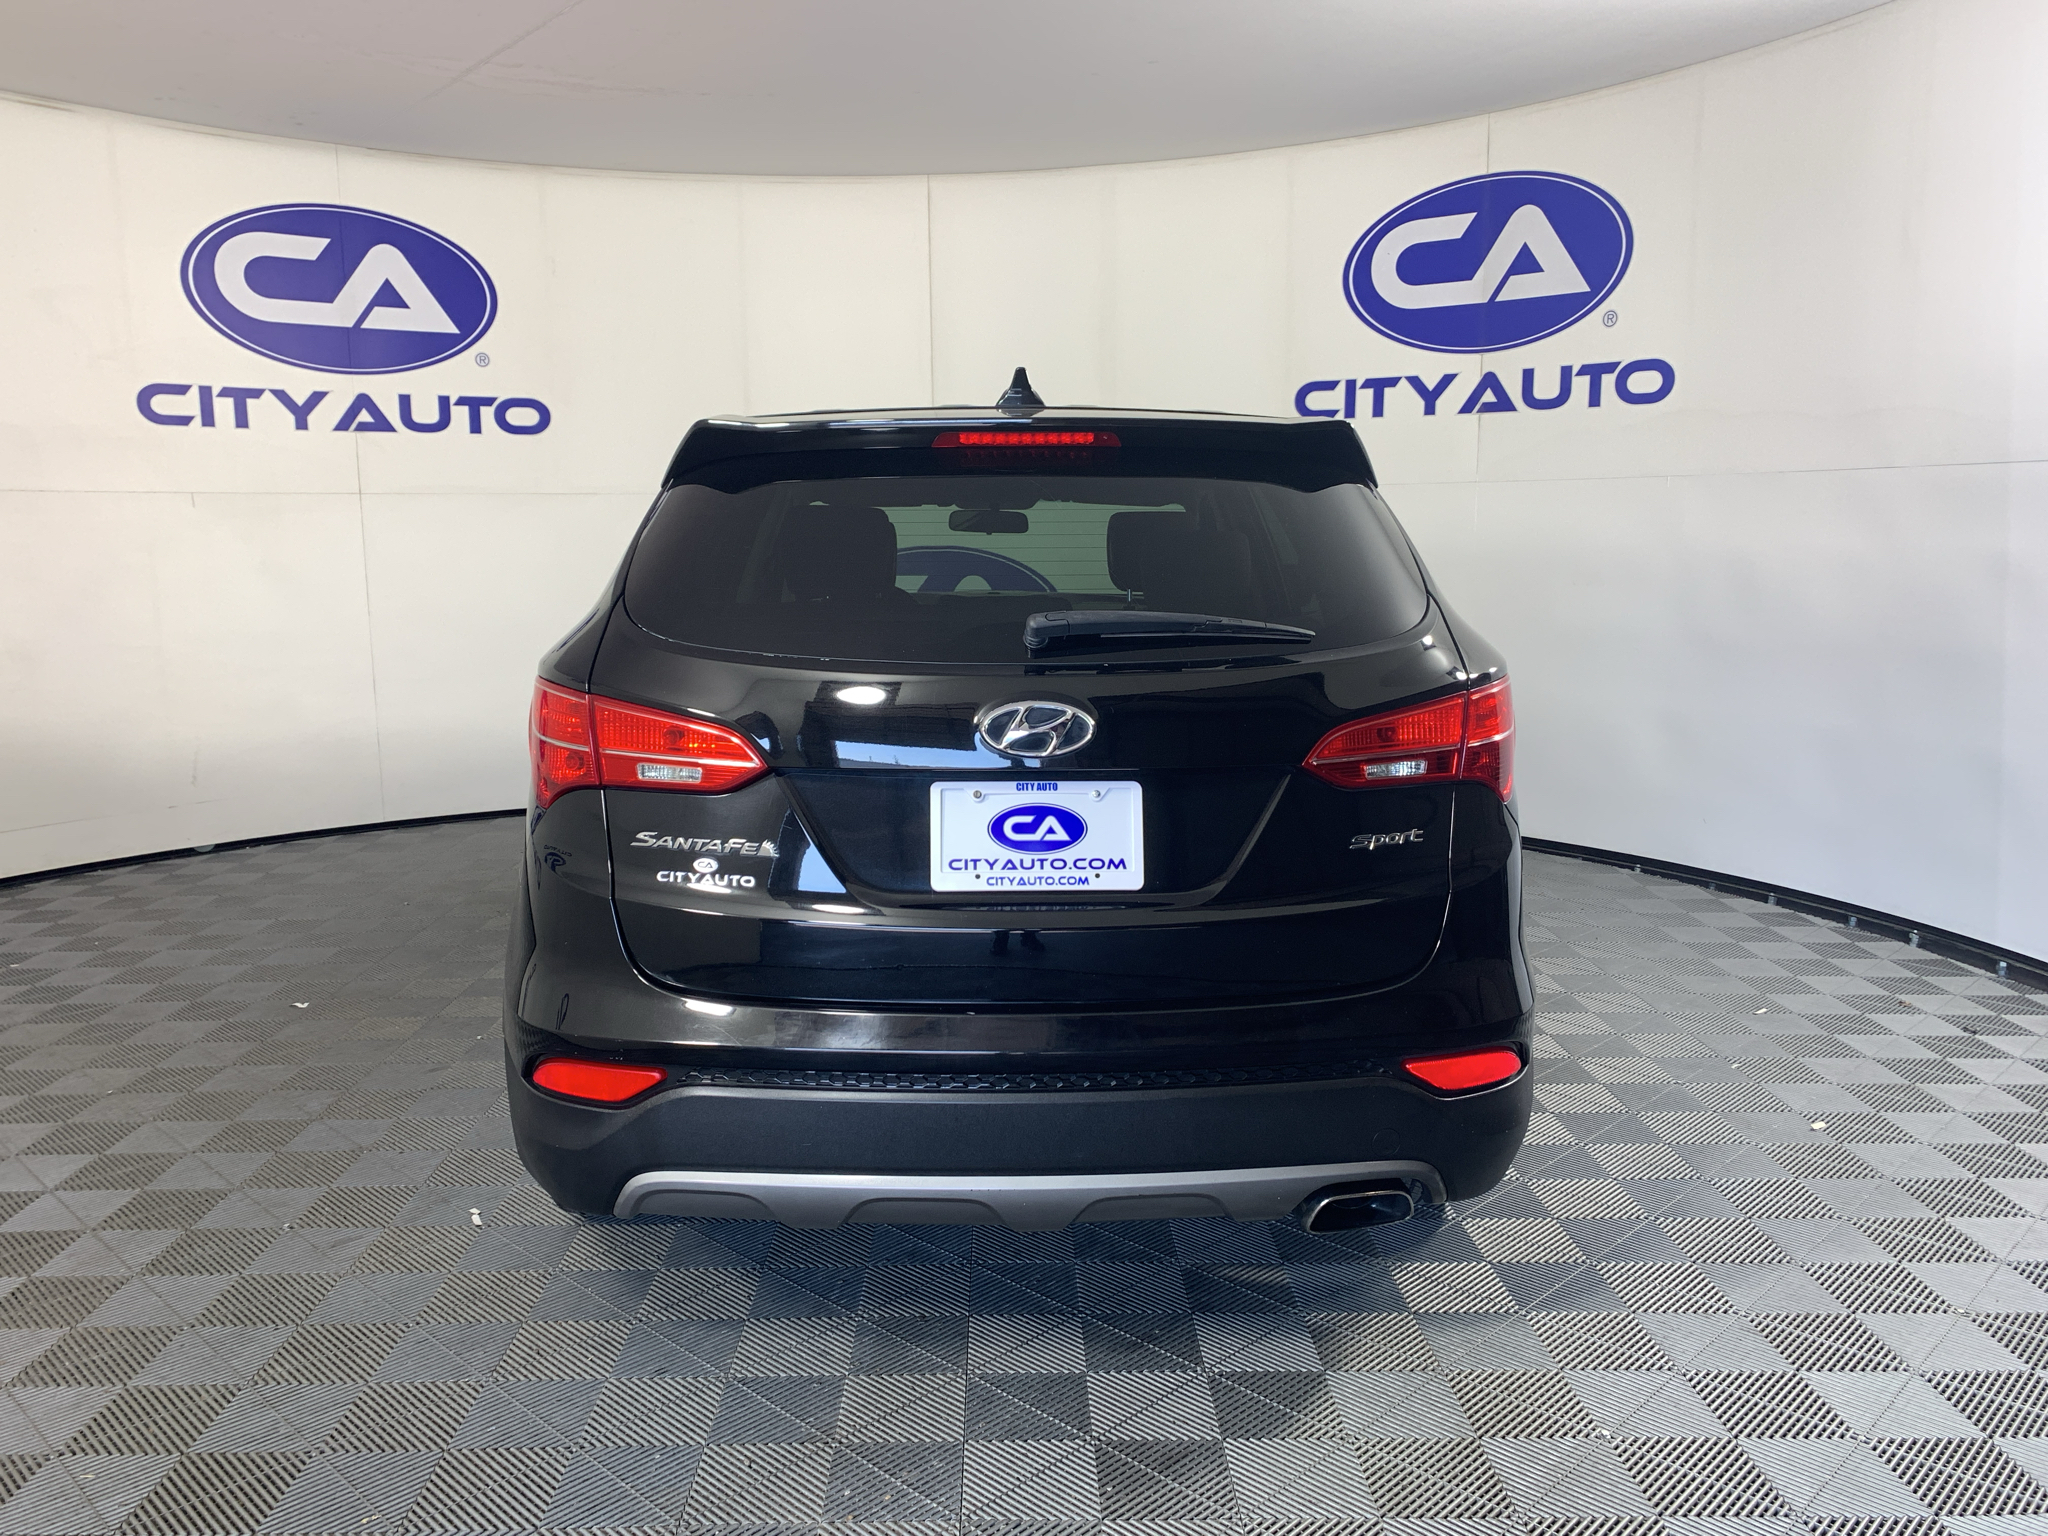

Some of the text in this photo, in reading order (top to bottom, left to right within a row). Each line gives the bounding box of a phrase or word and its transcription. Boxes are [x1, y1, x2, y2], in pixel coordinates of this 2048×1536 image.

[1371, 204, 1591, 309] CA
[214, 231, 460, 334] CA
[1016, 782, 1058, 791] CITY AUTO
[1003, 815, 1072, 841] CA
[948, 858, 1127, 871] CITYAUTO.COM
[986, 875, 1090, 886] CITYAUTO.COM
